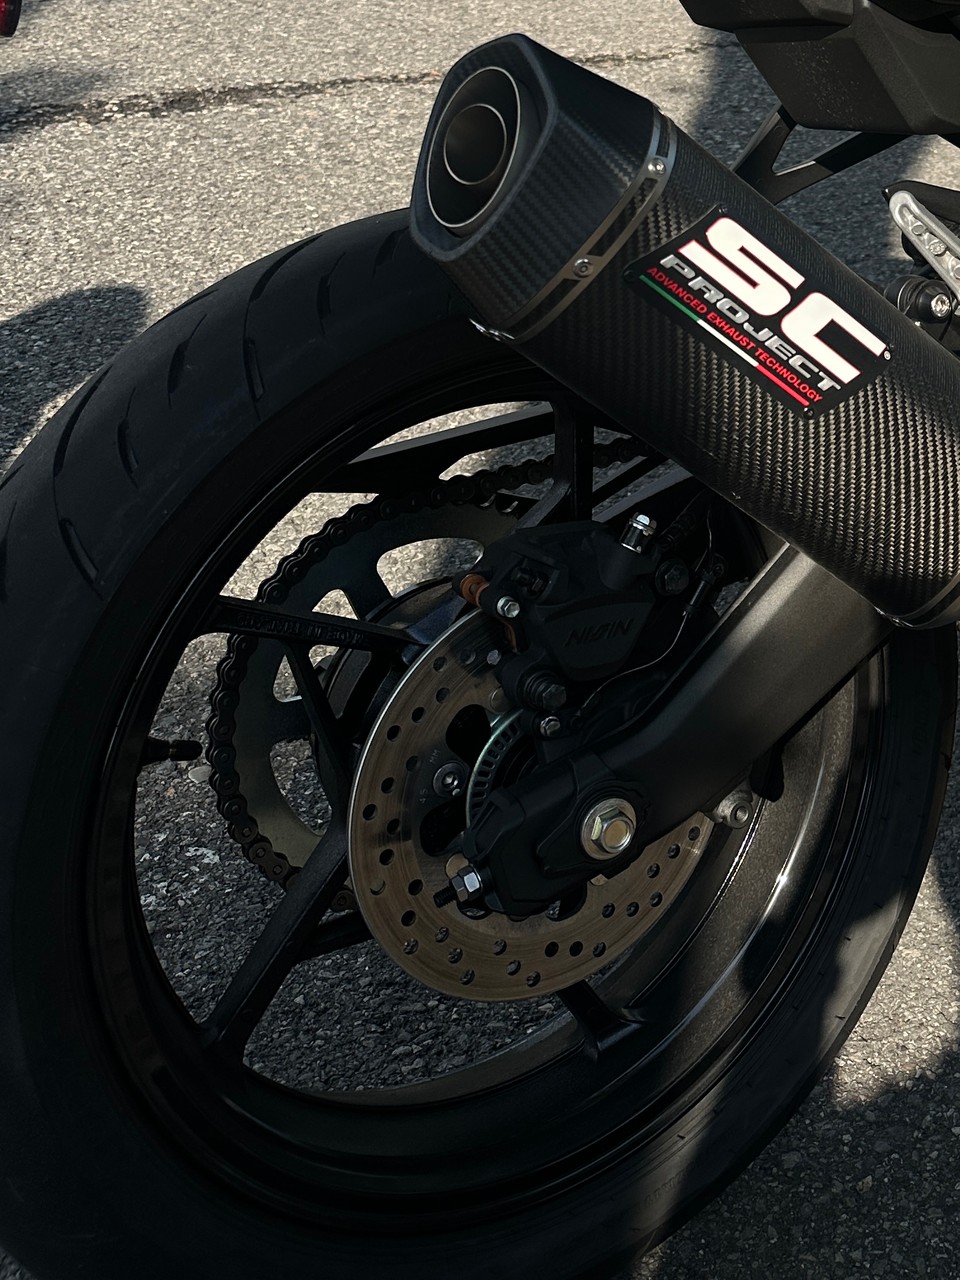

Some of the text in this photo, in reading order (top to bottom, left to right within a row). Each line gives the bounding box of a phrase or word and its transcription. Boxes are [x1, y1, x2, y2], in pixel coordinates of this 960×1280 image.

[647, 267, 823, 403] ADVANCED EXHAUST TECHNOLOGY
[659, 253, 842, 392] PROJECT
[677, 216, 888, 385] SC
